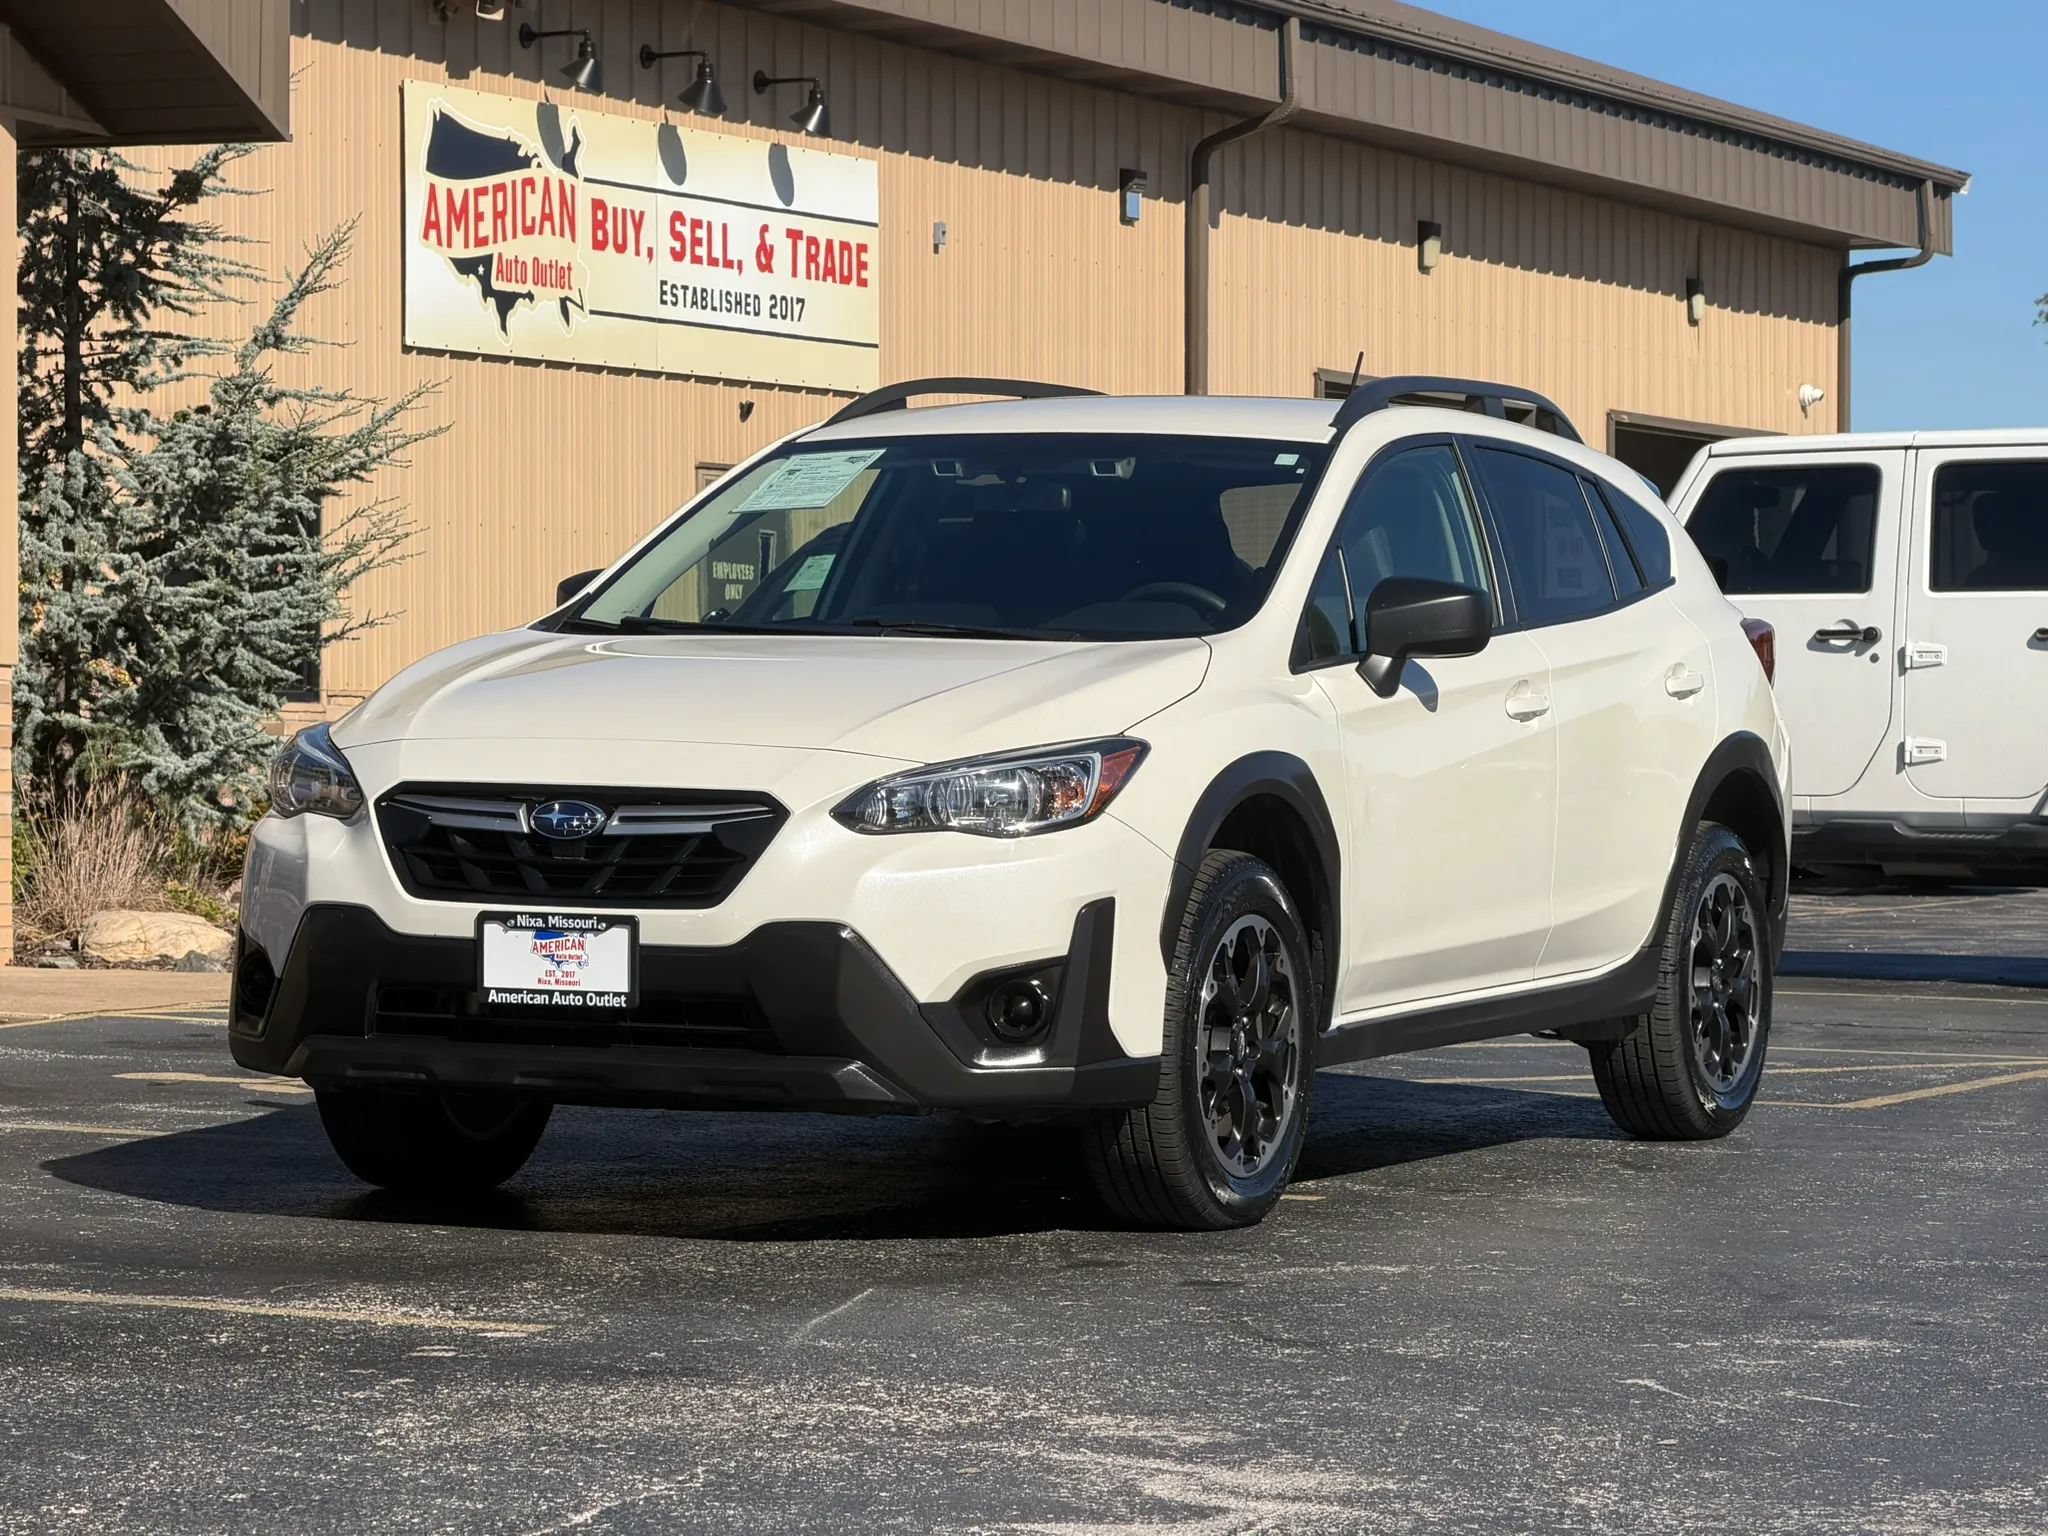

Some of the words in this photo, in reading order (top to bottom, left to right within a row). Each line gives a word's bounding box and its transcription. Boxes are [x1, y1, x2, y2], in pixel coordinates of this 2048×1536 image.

[423, 176, 576, 249] AMERICAN
[755, 224, 775, 274] &
[786, 228, 868, 288] TRADE
[496, 252, 528, 285] Auto
[532, 257, 573, 291] Outlet
[660, 280, 761, 317] ESTABLISHED
[769, 294, 806, 322] 2017
[712, 561, 755, 580] EMPLOYEES
[725, 583, 744, 600] ONLY
[548, 915, 598, 929] Missouri
[532, 938, 585, 954] AMERICAN
[538, 977, 552, 986] Nixa,
[554, 978, 581, 986] Missouri
[545, 970, 557, 978] EST.
[561, 970, 575, 978] 2017
[488, 989, 549, 1005] American
[552, 991, 583, 1006] Auto
[586, 992, 627, 1007] Outlet
